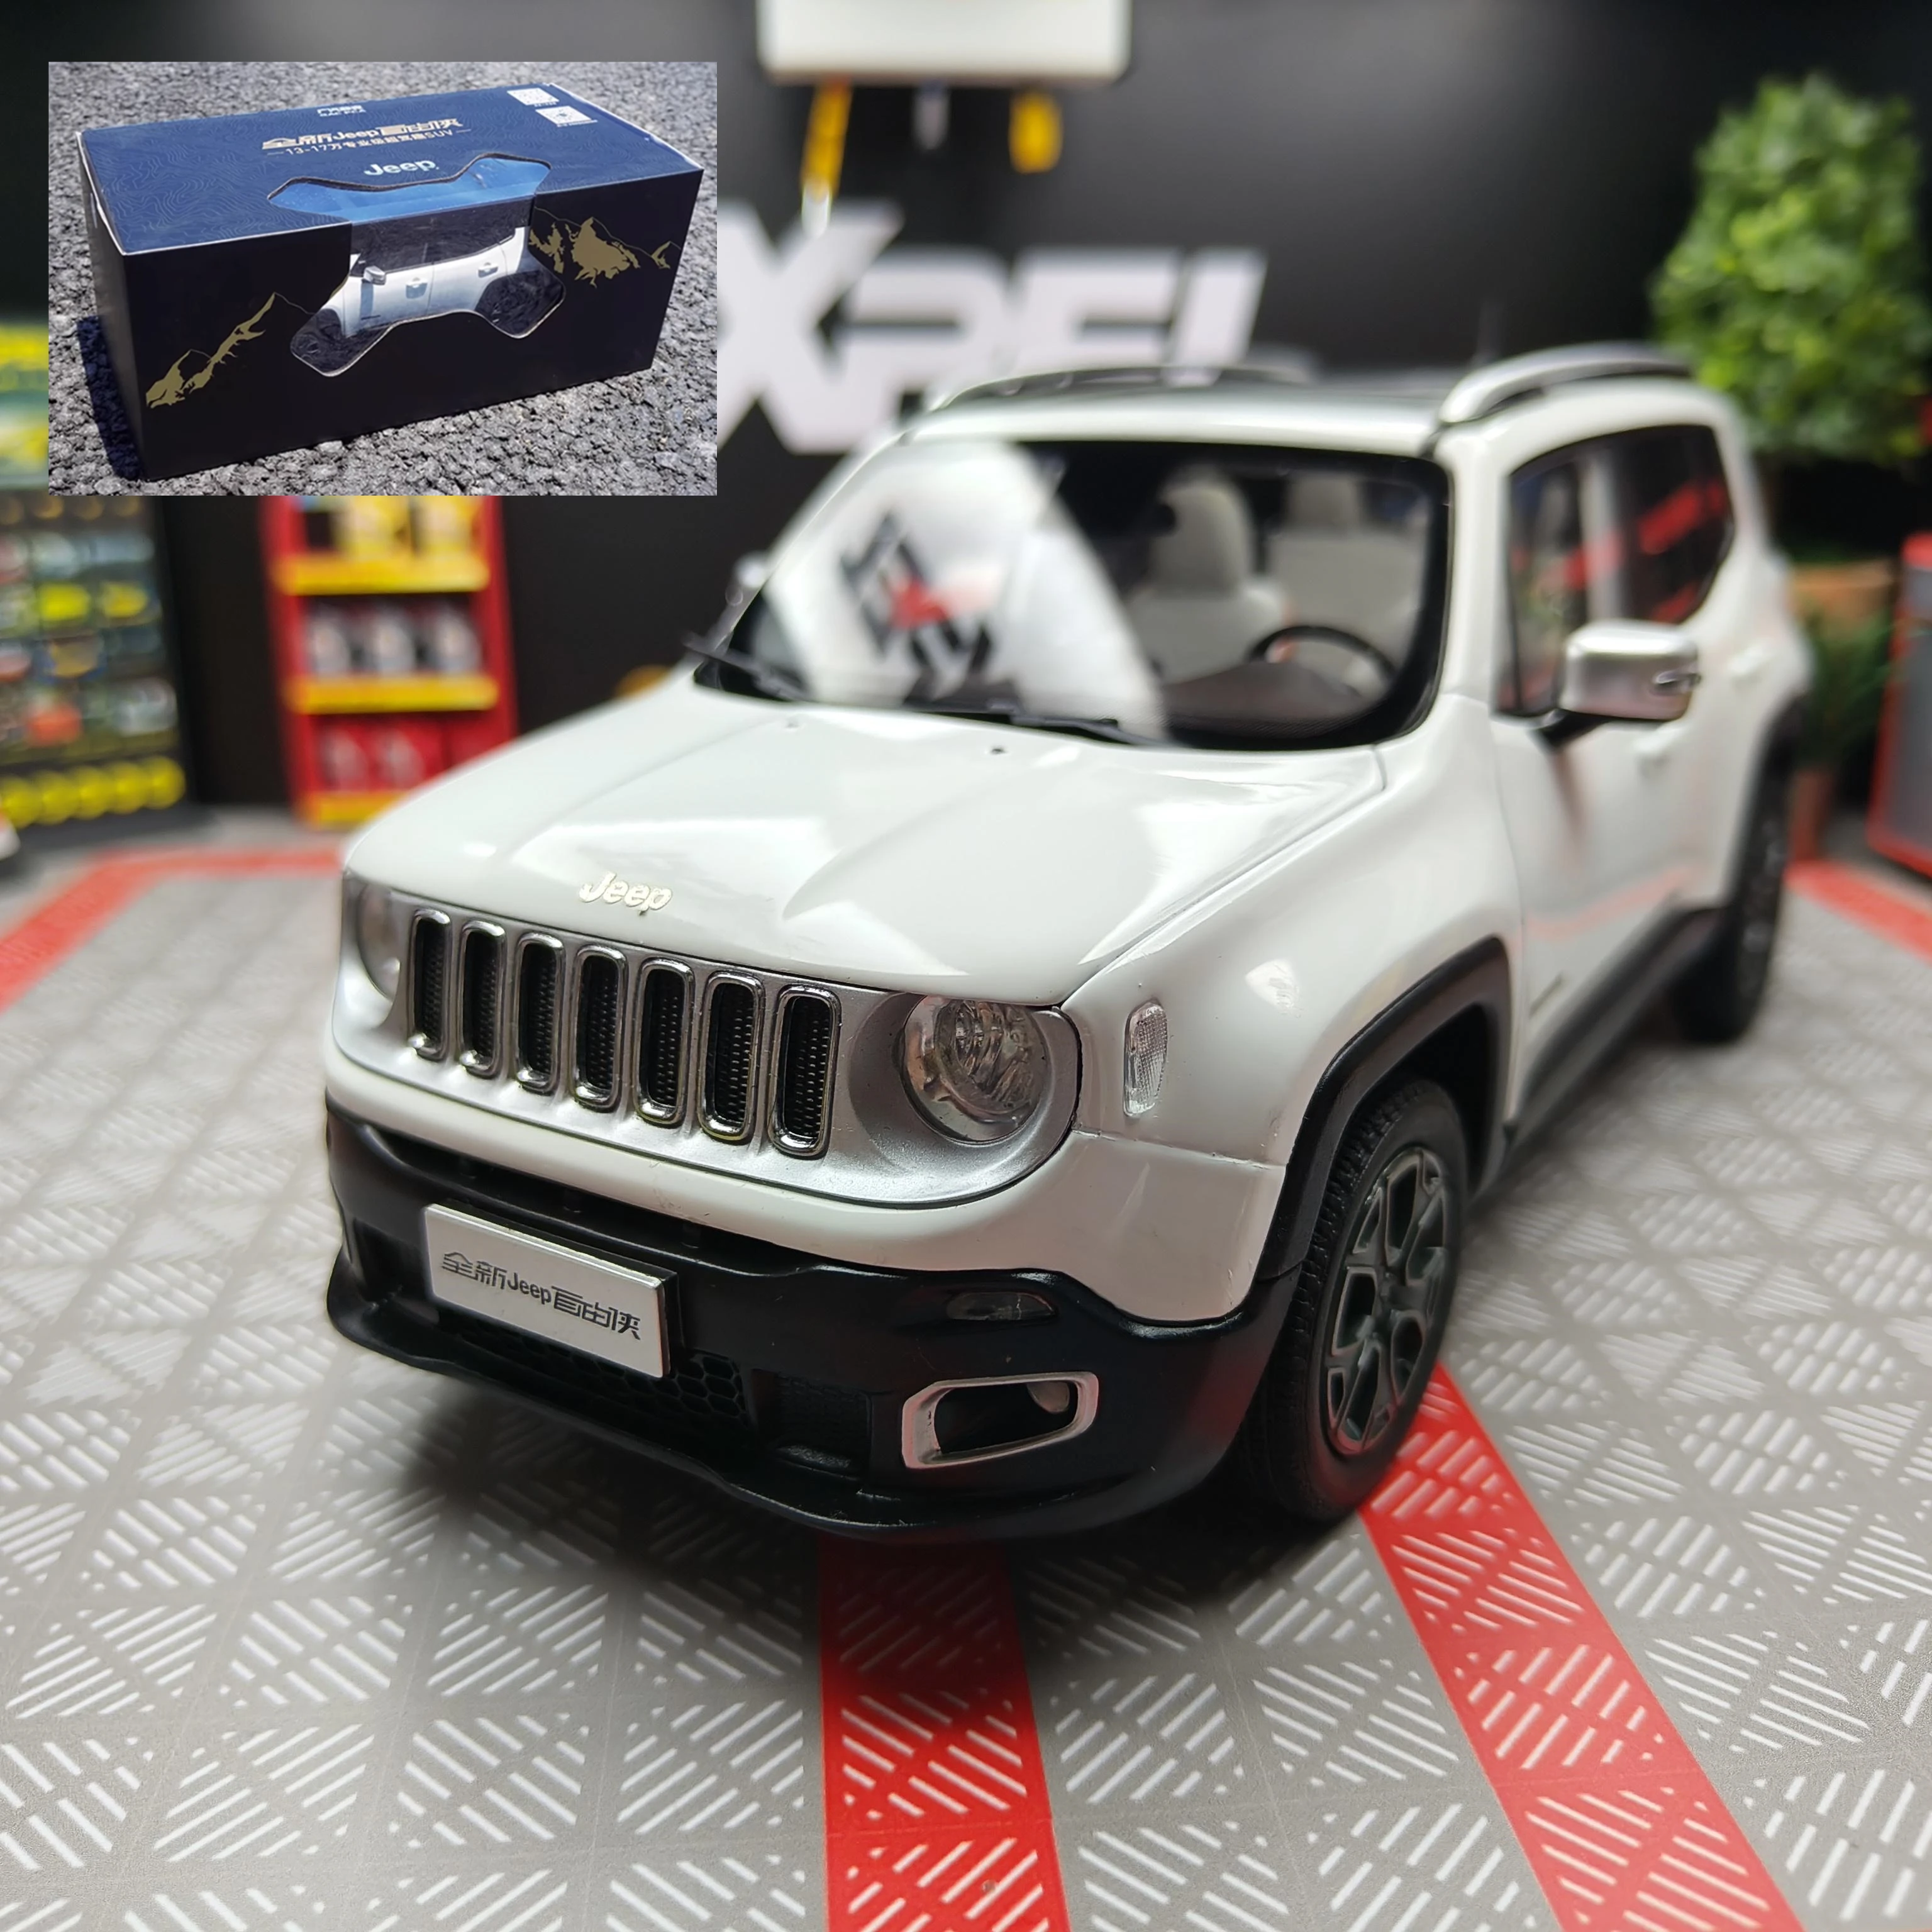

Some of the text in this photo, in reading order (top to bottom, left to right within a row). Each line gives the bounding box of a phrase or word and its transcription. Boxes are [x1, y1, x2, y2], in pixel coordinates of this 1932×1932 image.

[364, 160, 436, 175] Jeep
[579, 871, 672, 916] Jeep
[441, 1252, 641, 1340] 全新Jeep自由侠
